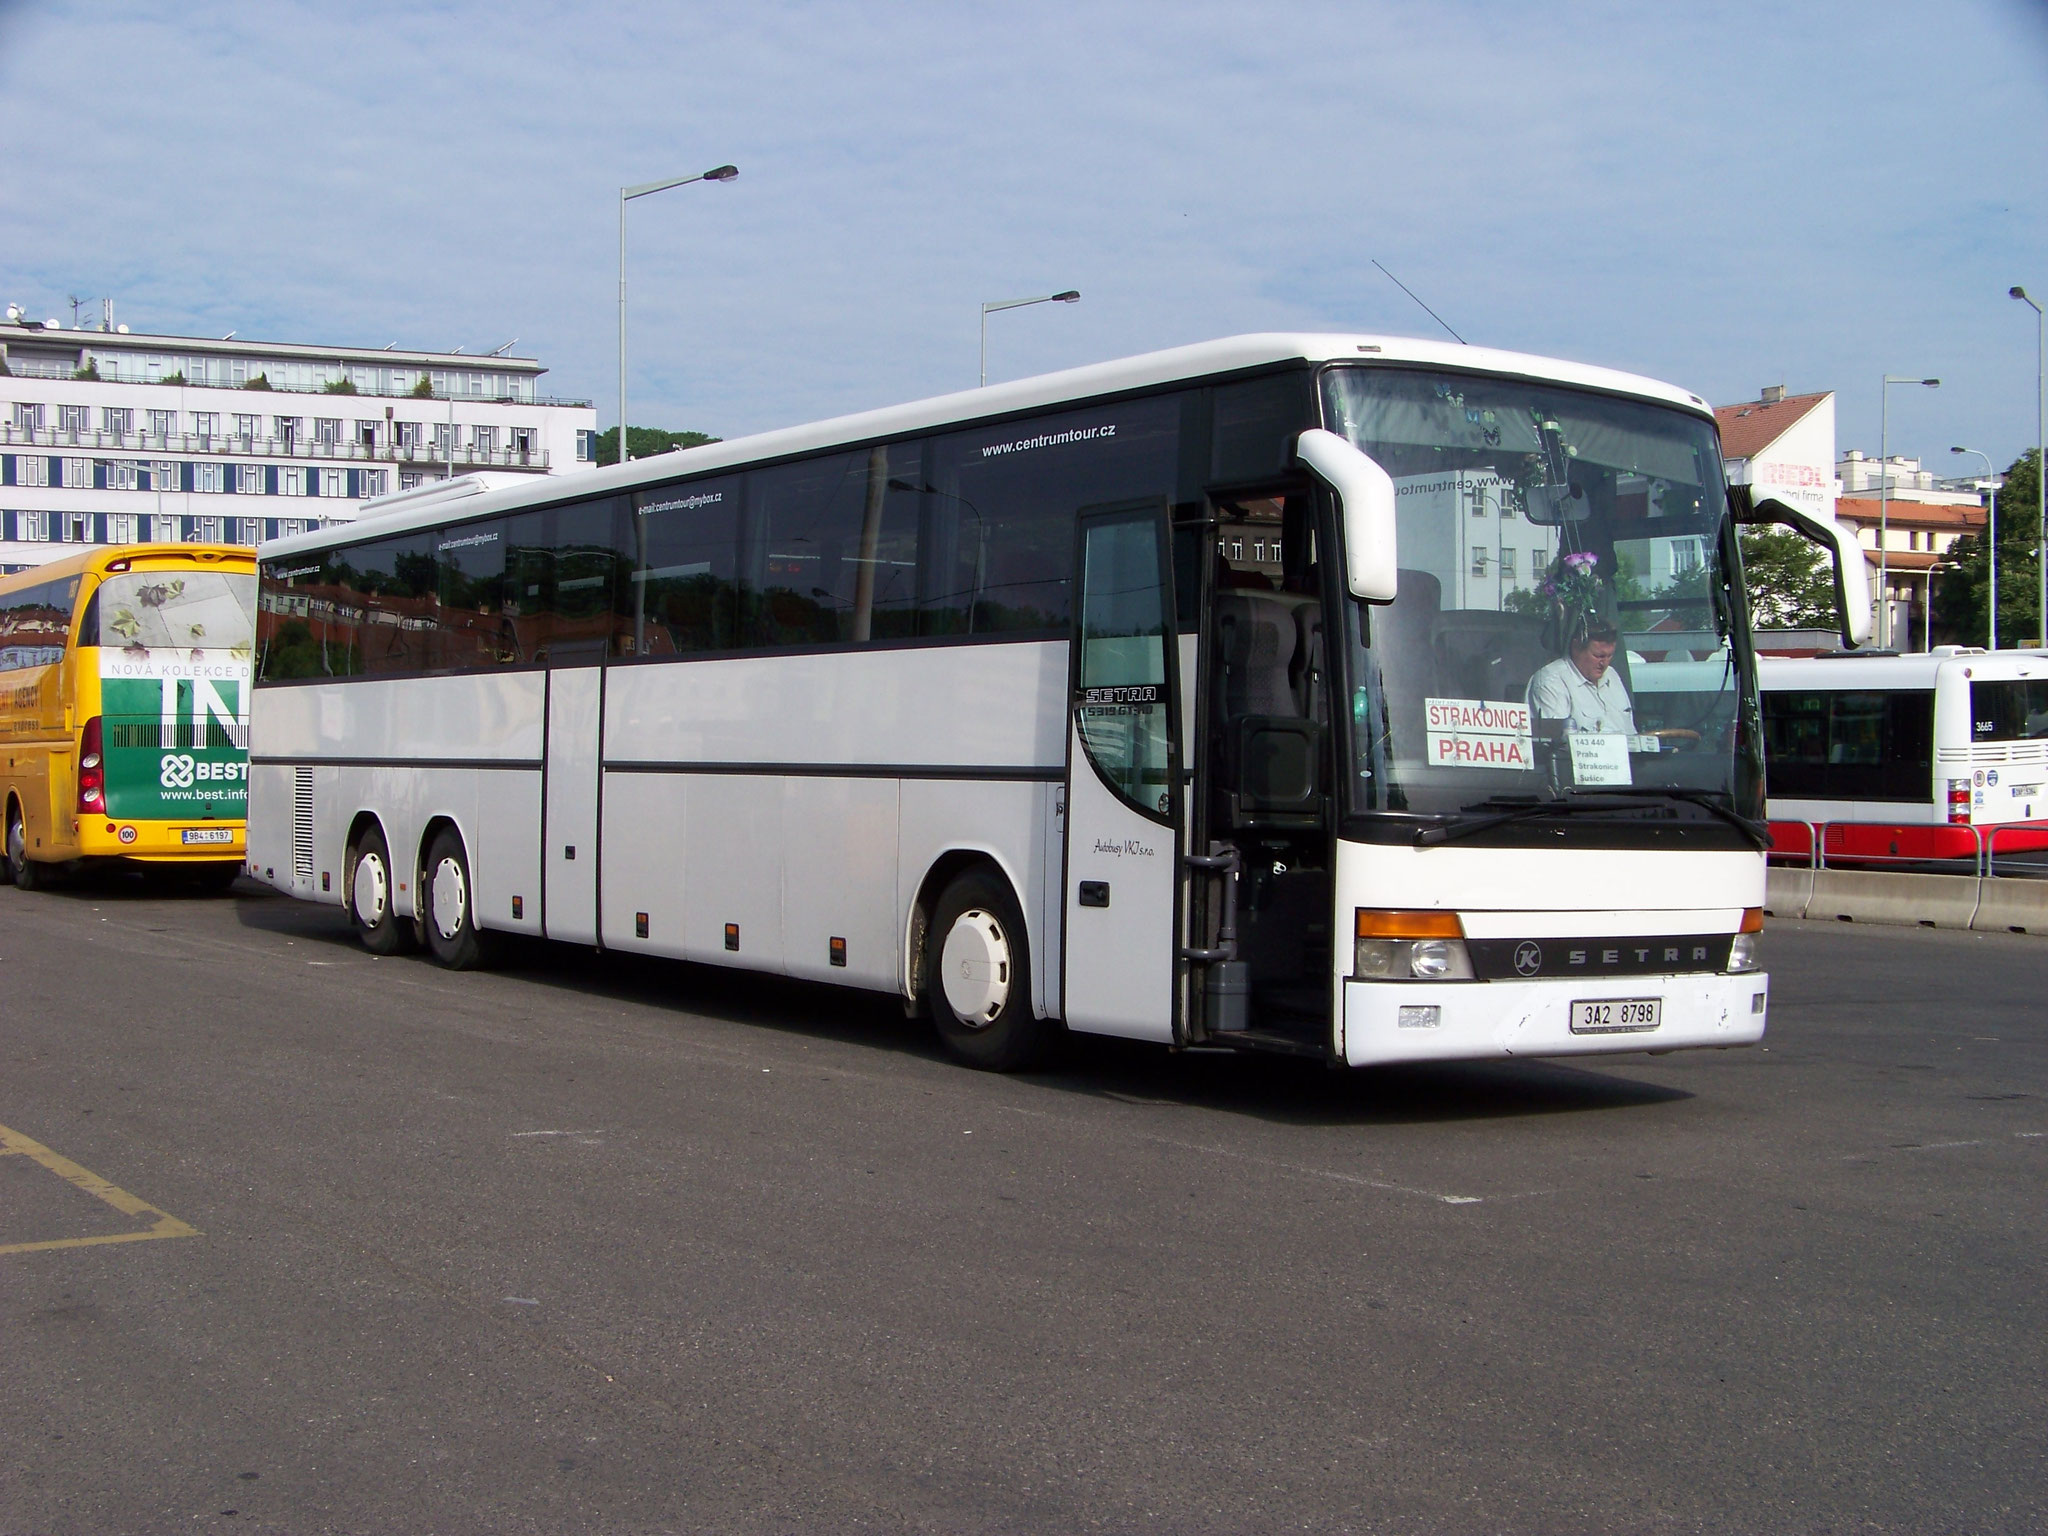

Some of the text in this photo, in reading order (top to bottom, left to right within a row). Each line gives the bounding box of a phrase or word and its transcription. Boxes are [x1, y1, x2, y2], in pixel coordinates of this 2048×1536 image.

[981, 424, 1116, 457] www.centrumtour.cz
[111, 663, 153, 675] NOVÁ
[162, 665, 233, 676] KOLEKCE
[1086, 686, 1156, 703] SETRA
[1430, 705, 1528, 729] STRAKONICE
[1975, 721, 1993, 732] 3665
[1439, 739, 1522, 763] PRAHA
[196, 763, 248, 780] BEST
[122, 830, 134, 839] 100
[189, 832, 229, 840] 9B4 6197
[1093, 838, 1122, 858] Autobusy
[1569, 946, 1707, 965] SETRA
[1584, 1003, 1654, 1025] 3A2 8798
